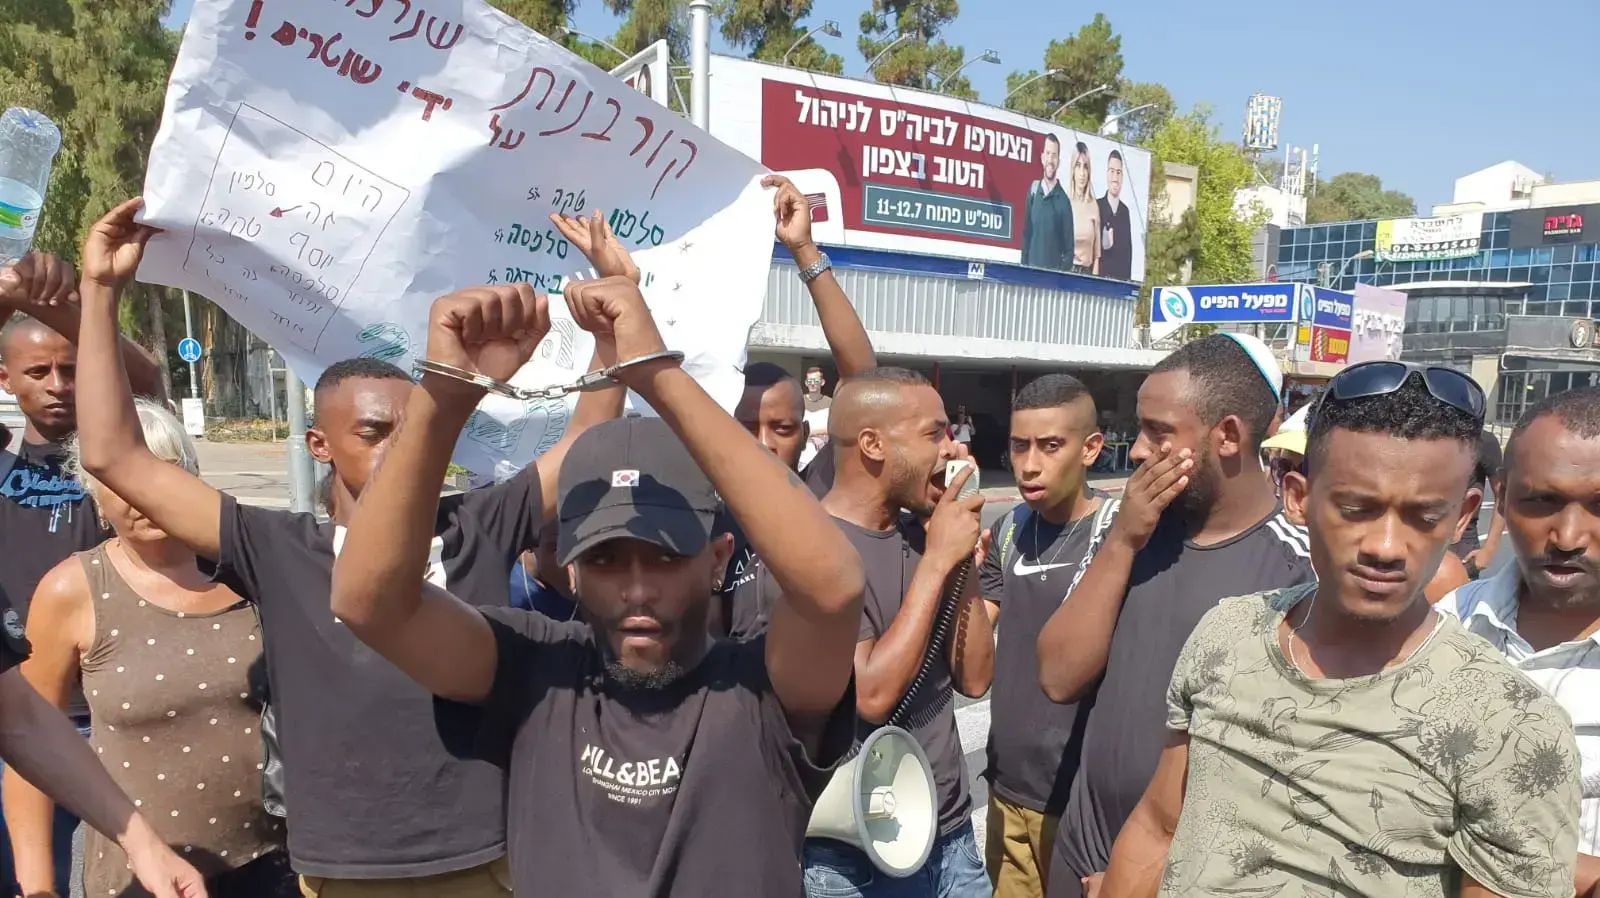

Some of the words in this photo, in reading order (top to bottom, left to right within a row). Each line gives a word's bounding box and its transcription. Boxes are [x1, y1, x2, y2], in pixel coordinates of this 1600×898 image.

[270, 20, 382, 84] שוטרים
[397, 80, 453, 121] ידי
[795, 89, 872, 131] לניהול
[489, 114, 525, 150] על
[489, 67, 697, 200] קורבנות
[964, 124, 1032, 163] הצטרפו
[862, 145, 926, 180] בצפון
[932, 156, 984, 189] הטוב
[312, 161, 383, 212] היום
[551, 188, 586, 215] טקה
[876, 198, 921, 221] 11-12.7
[926, 204, 961, 224] פתוח
[289, 232, 334, 269] יוסף
[1200, 295, 1240, 309] הפיס
[1241, 292, 1288, 310] מפעל
[608, 793, 625, 803] SINCE
[627, 796, 641, 804] 1991
[621, 786, 648, 795] MEXICO
